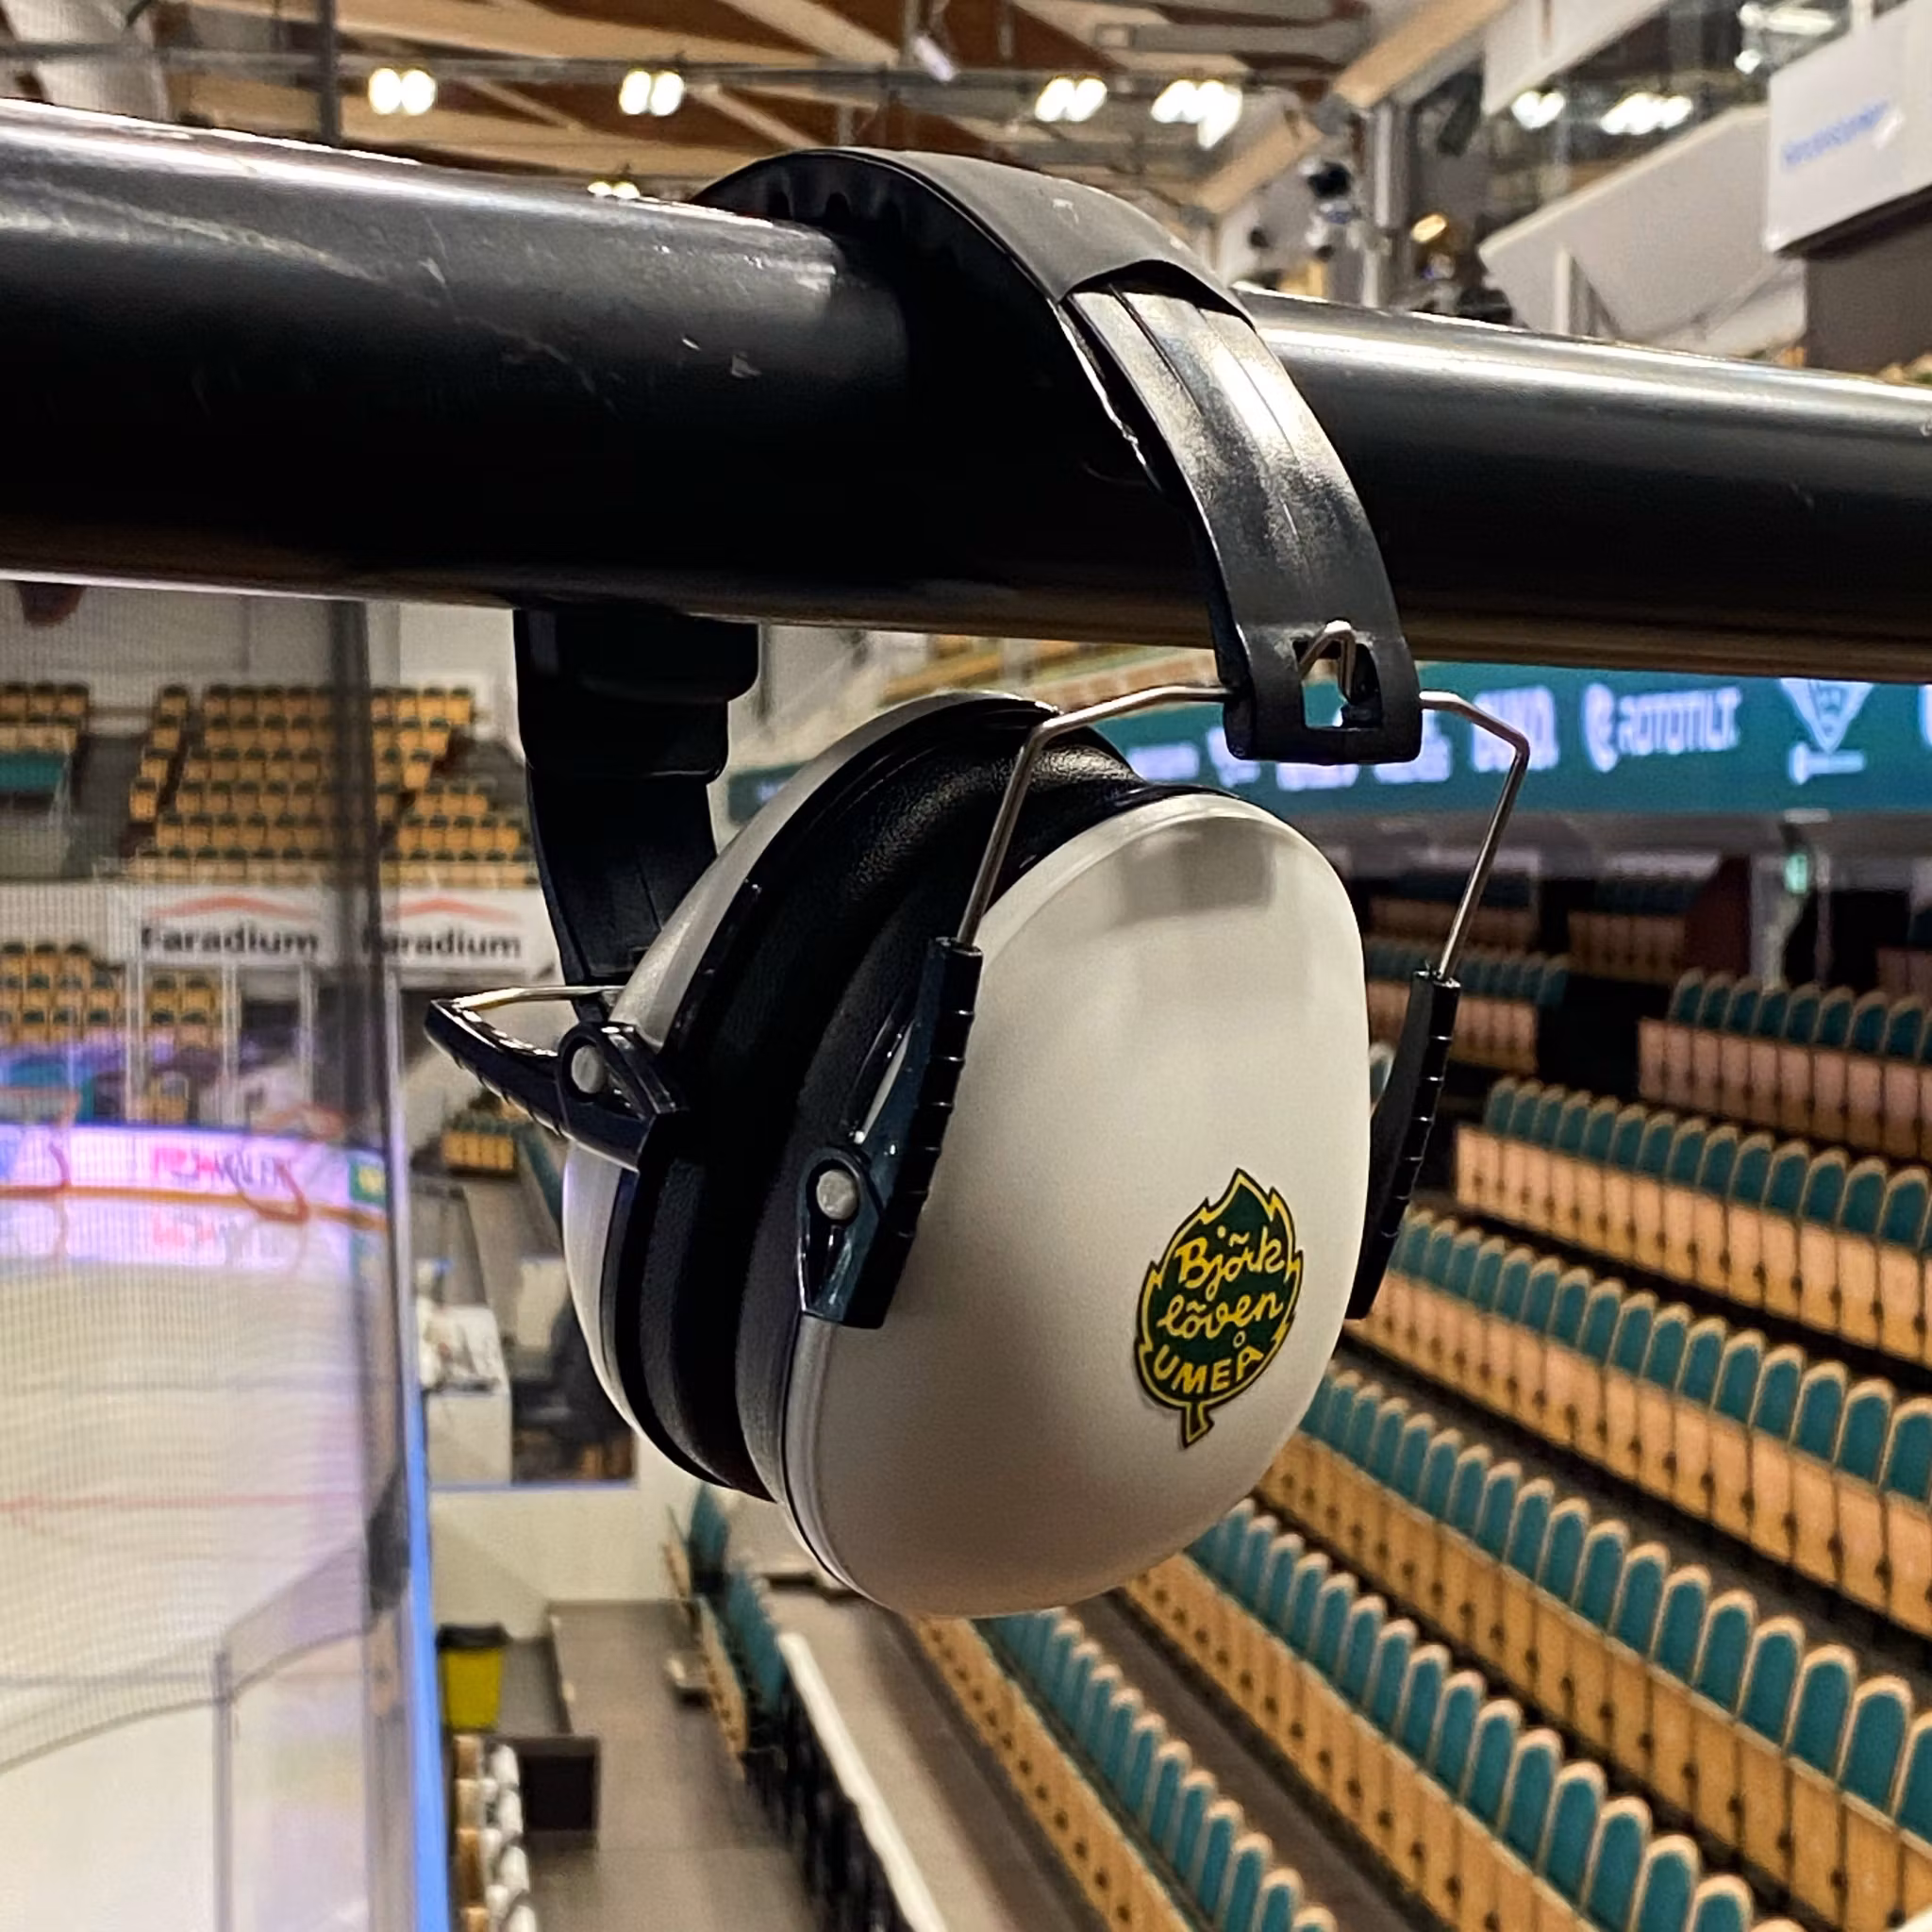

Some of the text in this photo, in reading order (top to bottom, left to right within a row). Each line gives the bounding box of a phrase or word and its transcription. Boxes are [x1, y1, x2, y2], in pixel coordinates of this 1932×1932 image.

[141, 920, 321, 955] Faradium
[1173, 1225, 1286, 1302] Björk
[1155, 1291, 1285, 1341] löven
[1152, 1331, 1265, 1395] UMEÅ
